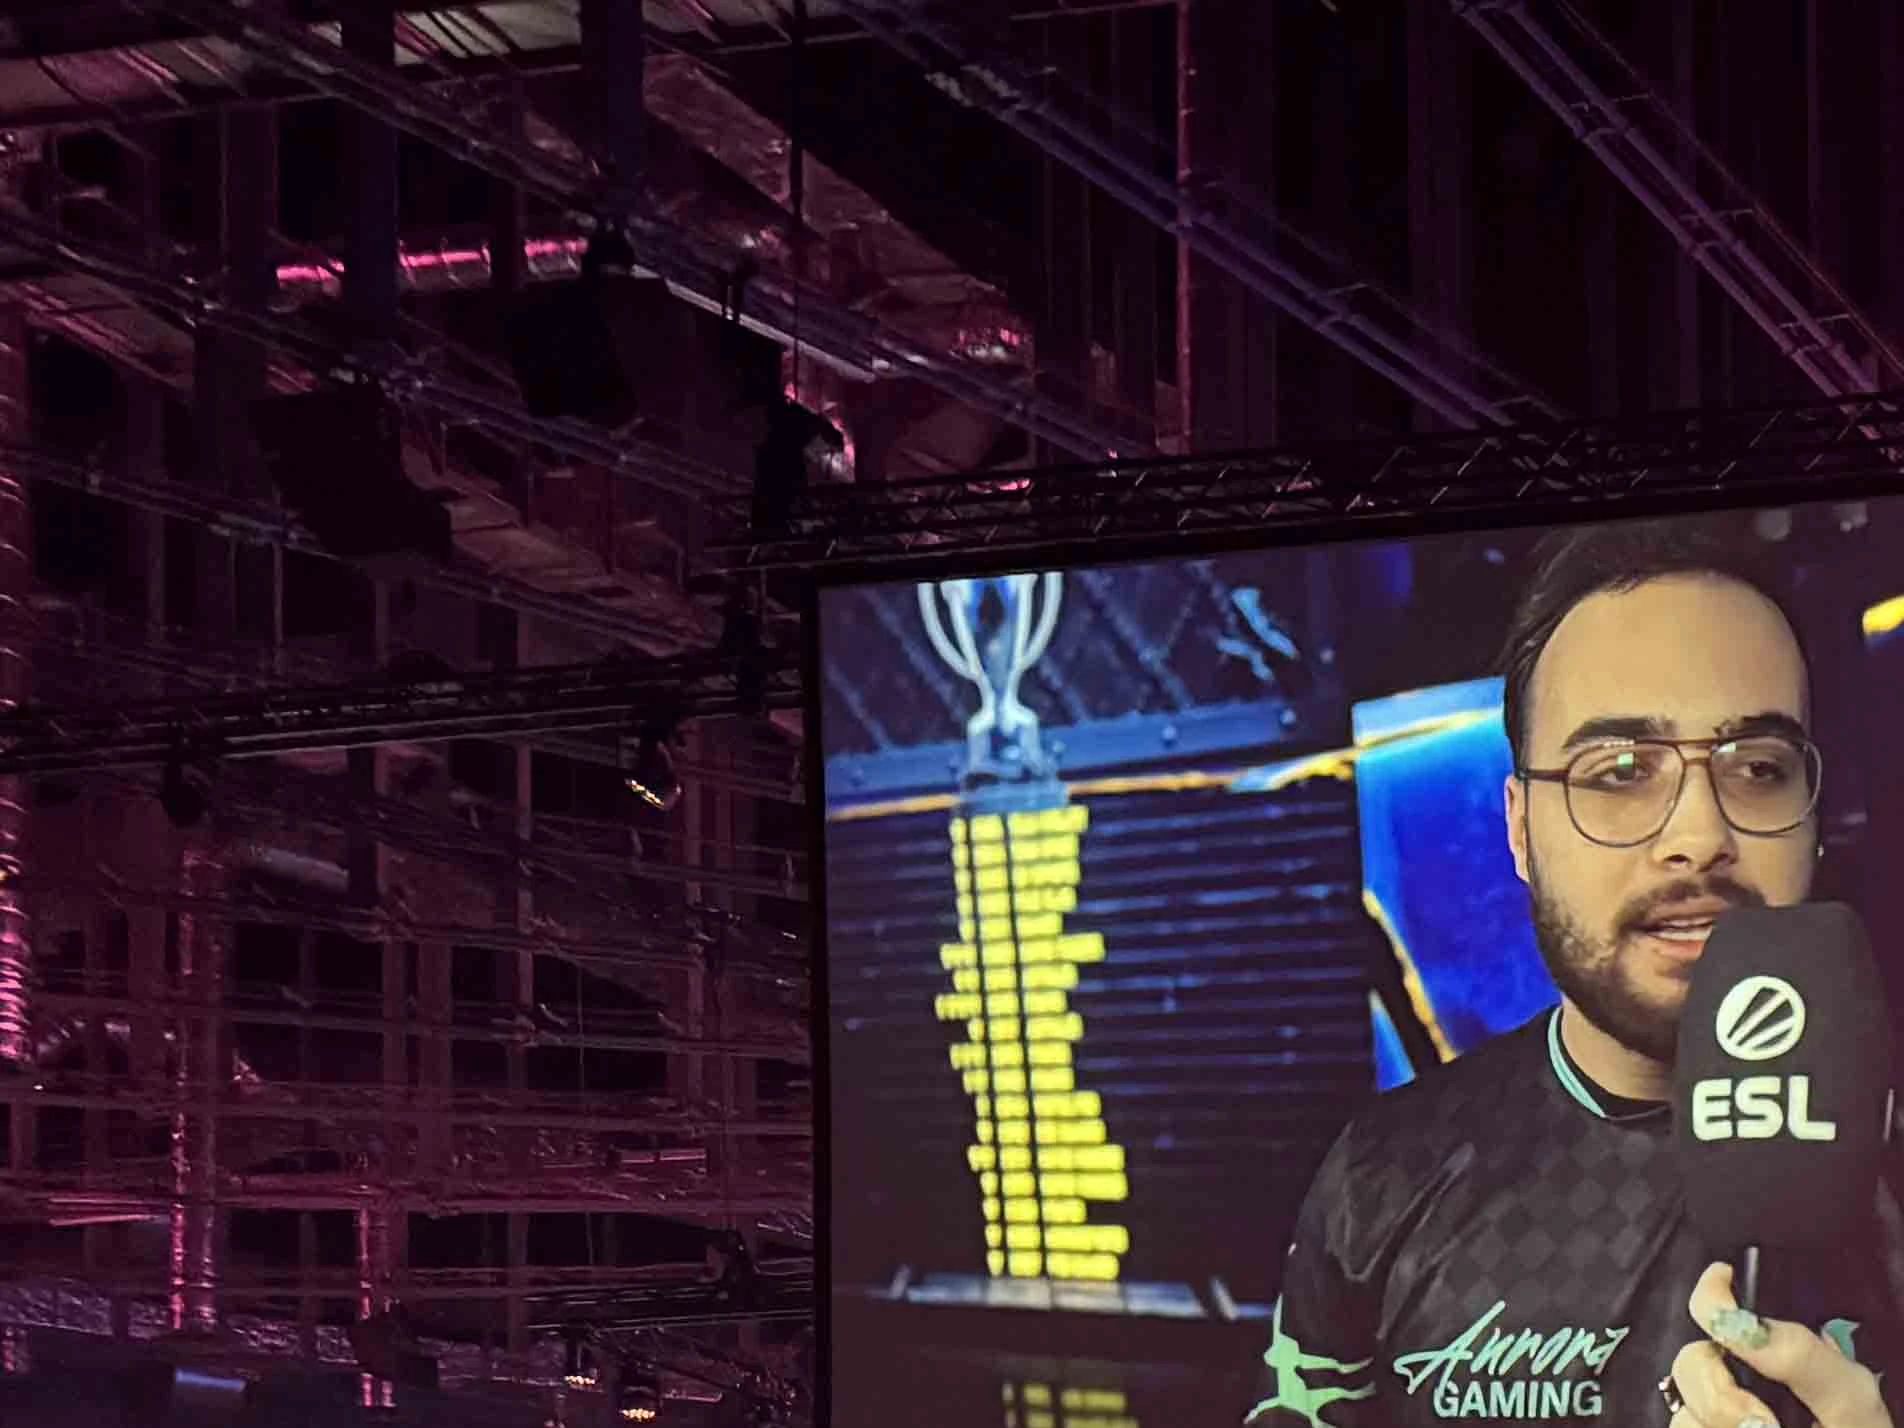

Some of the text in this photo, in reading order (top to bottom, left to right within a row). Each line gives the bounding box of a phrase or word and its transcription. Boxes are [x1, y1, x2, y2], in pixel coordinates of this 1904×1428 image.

[1693, 1075, 1837, 1140] ESL
[1393, 1301, 1629, 1395] Aurora
[1433, 1380, 1603, 1418] GAMING
